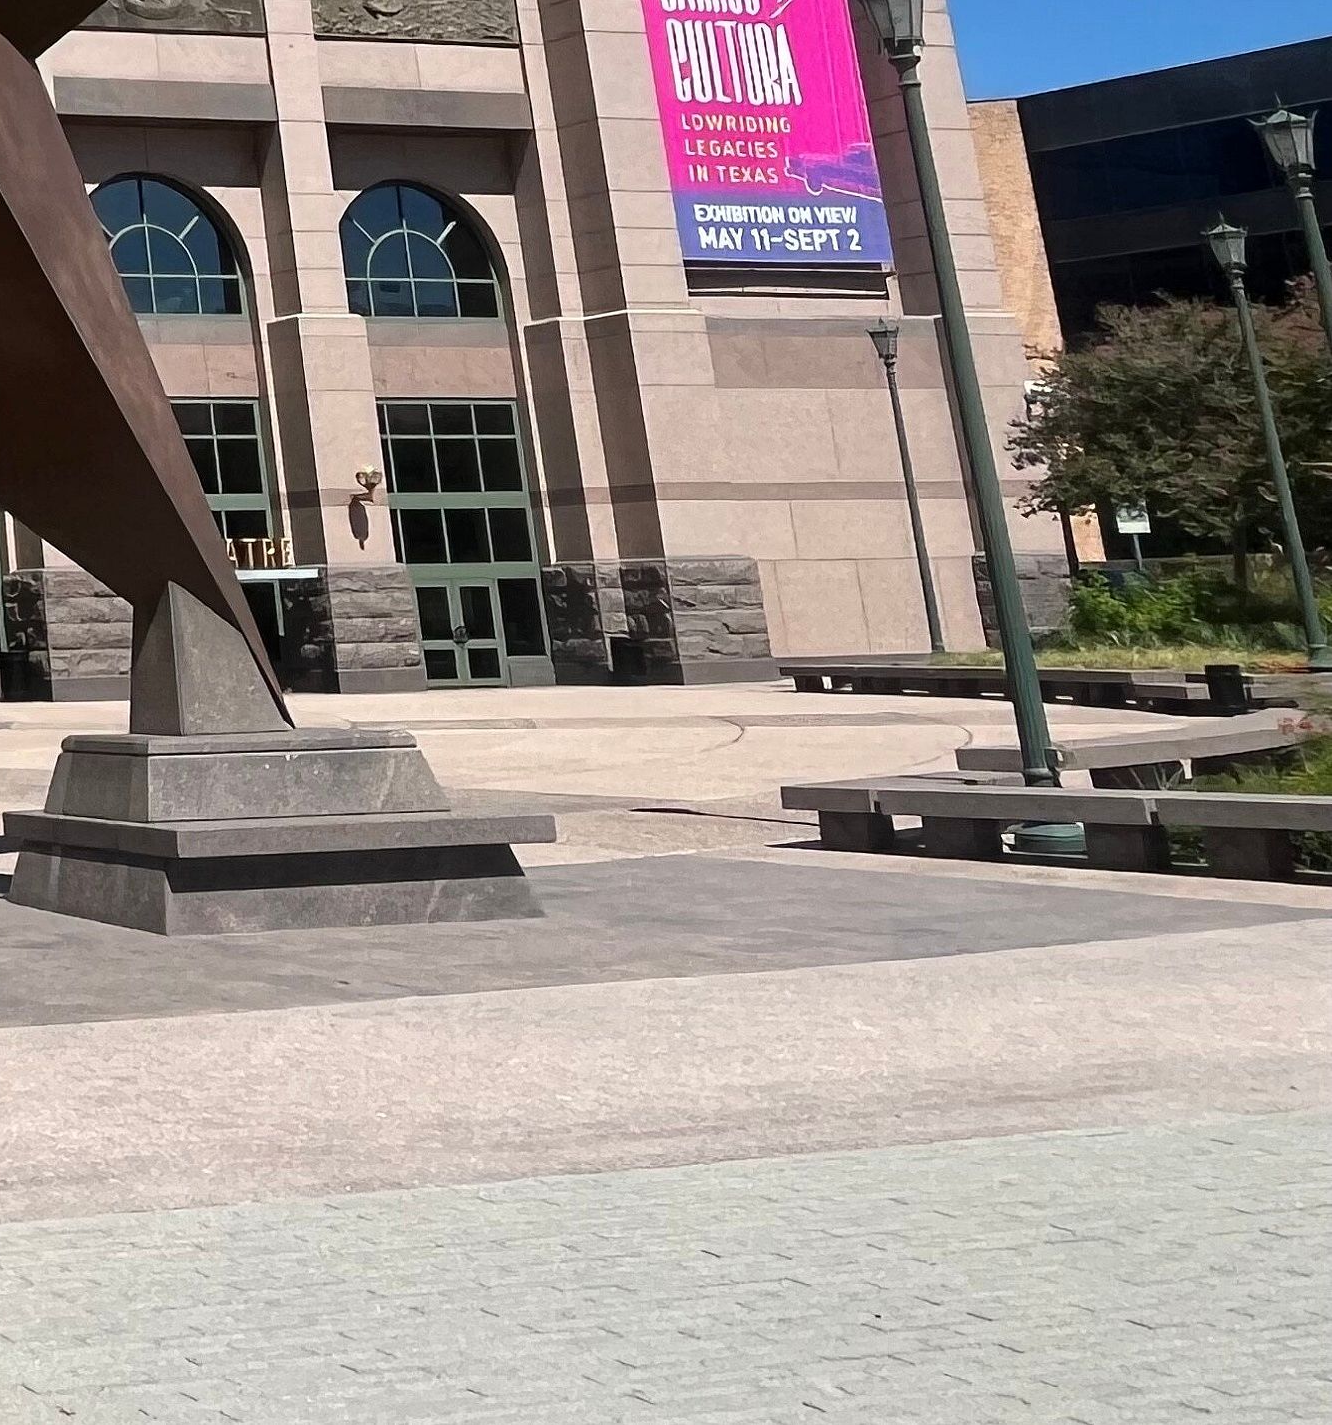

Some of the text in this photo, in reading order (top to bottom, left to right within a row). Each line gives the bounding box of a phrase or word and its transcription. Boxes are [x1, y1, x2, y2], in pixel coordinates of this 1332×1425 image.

[665, 17, 804, 107] CULTURA
[680, 112, 792, 134] LOWRIDING
[684, 138, 780, 159] LEGACIES
[688, 163, 780, 184] IN TEXAS
[692, 203, 858, 225] EXHIBITION ON VIEW
[697, 226, 744, 251] MAY
[846, 228, 863, 252] 2
